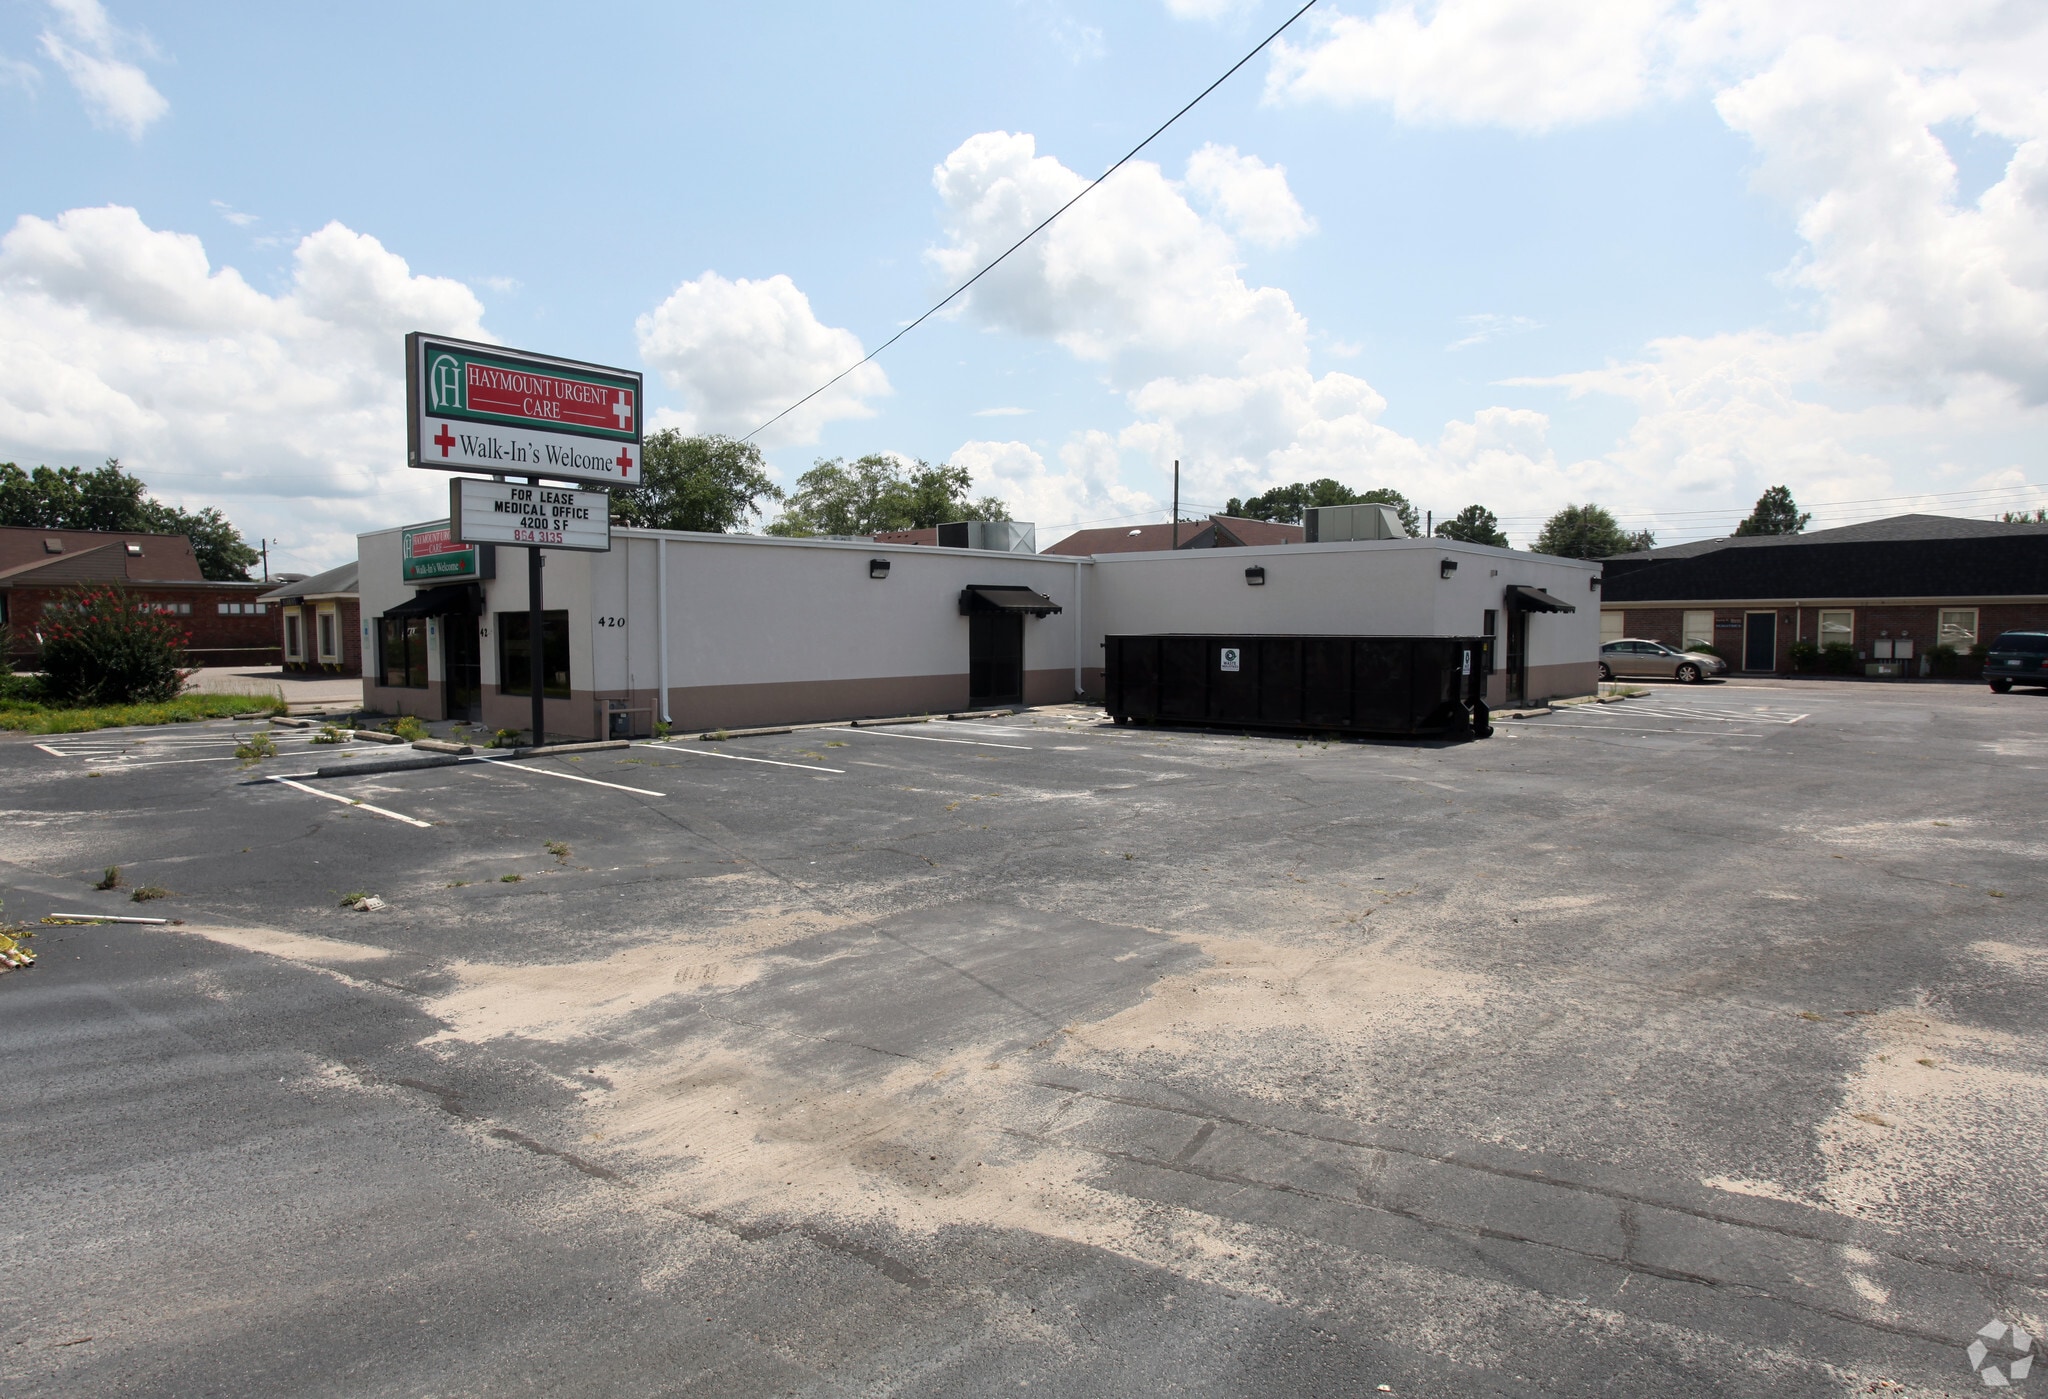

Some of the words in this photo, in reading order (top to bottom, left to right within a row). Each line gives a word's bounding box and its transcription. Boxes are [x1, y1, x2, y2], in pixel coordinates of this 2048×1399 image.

[469, 367, 552, 397] HAYMOUNT
[555, 381, 608, 406] URGENT
[523, 397, 561, 419] CARE
[459, 434, 540, 464] Walk-In's
[545, 444, 613, 472] Welcome
[511, 488, 532, 502] FOR
[540, 491, 574, 506] LEASE
[494, 500, 546, 517] MEDICAL
[552, 505, 589, 520] OFFICE
[520, 516, 549, 530] 4200
[440, 529, 451, 542] URG
[514, 529, 535, 542] 864
[538, 531, 563, 544] 3135
[428, 543, 442, 554] CARE
[436, 561, 459, 573] Welcome
[598, 616, 626, 628] 420
